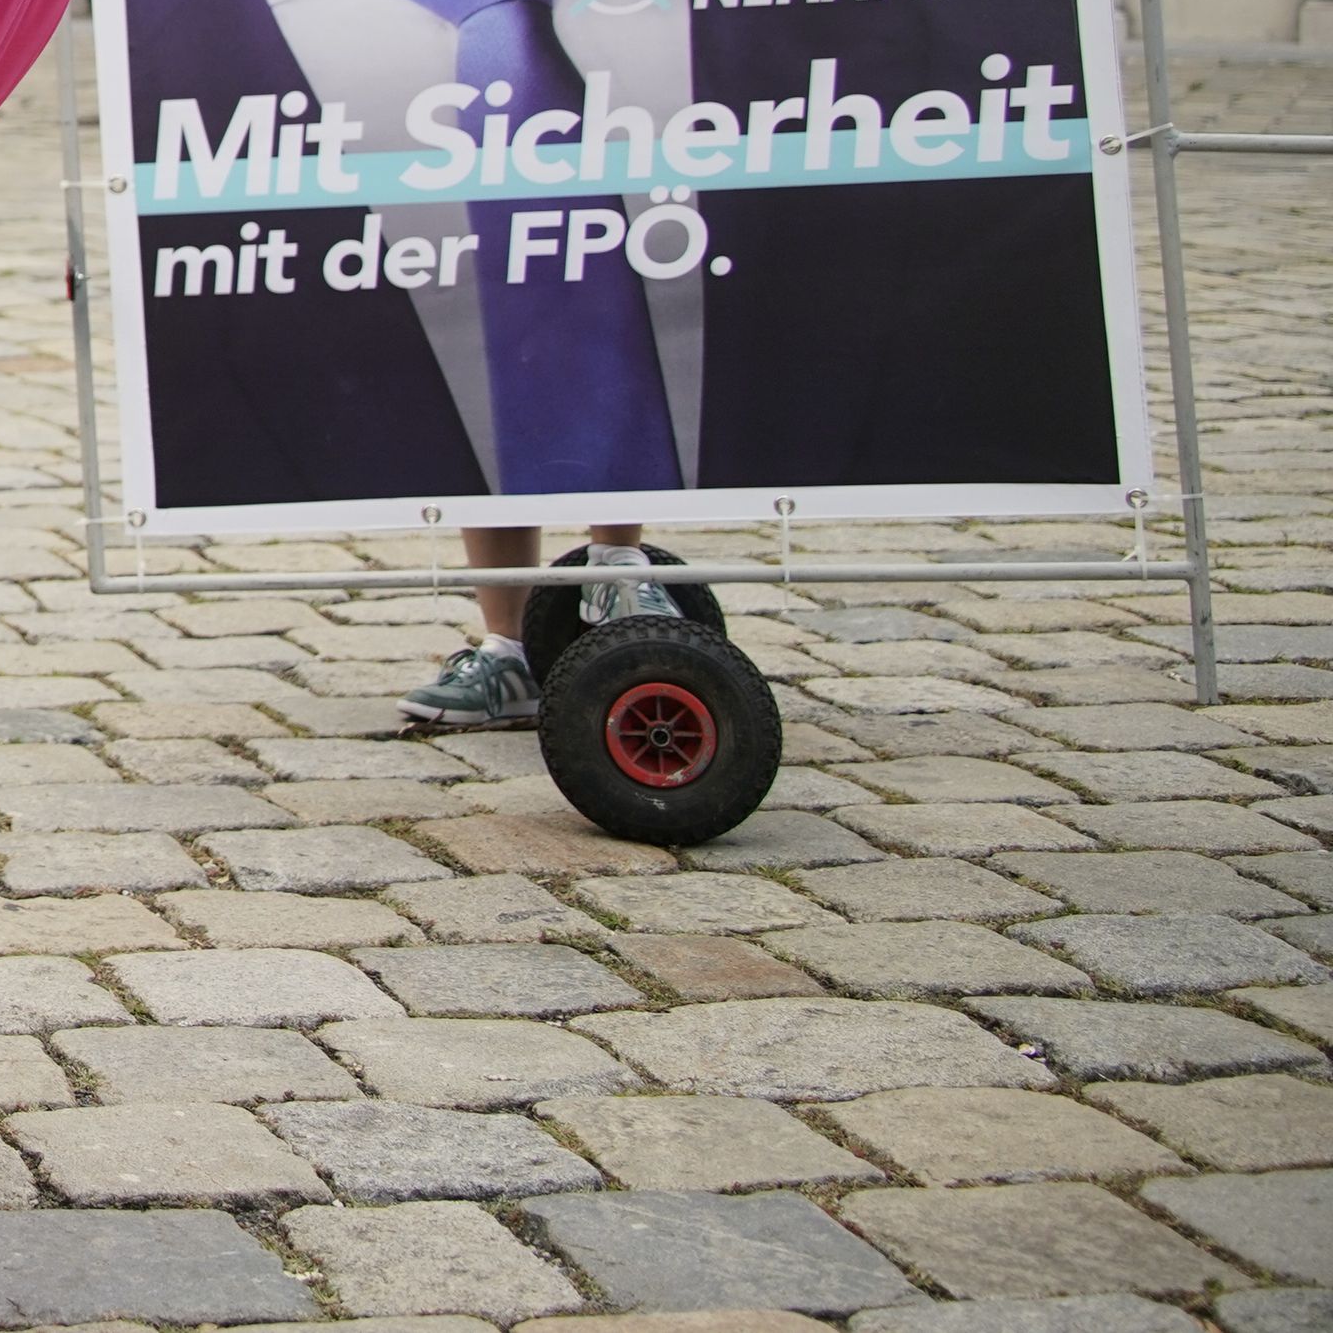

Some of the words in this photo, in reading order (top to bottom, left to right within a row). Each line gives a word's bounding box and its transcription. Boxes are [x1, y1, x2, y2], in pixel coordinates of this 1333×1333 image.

[152, 90, 363, 200] Mit
[400, 53, 1075, 190] Sicherheit
[154, 220, 298, 298] mit
[322, 212, 479, 291] der
[507, 185, 732, 284] FPÖ.
